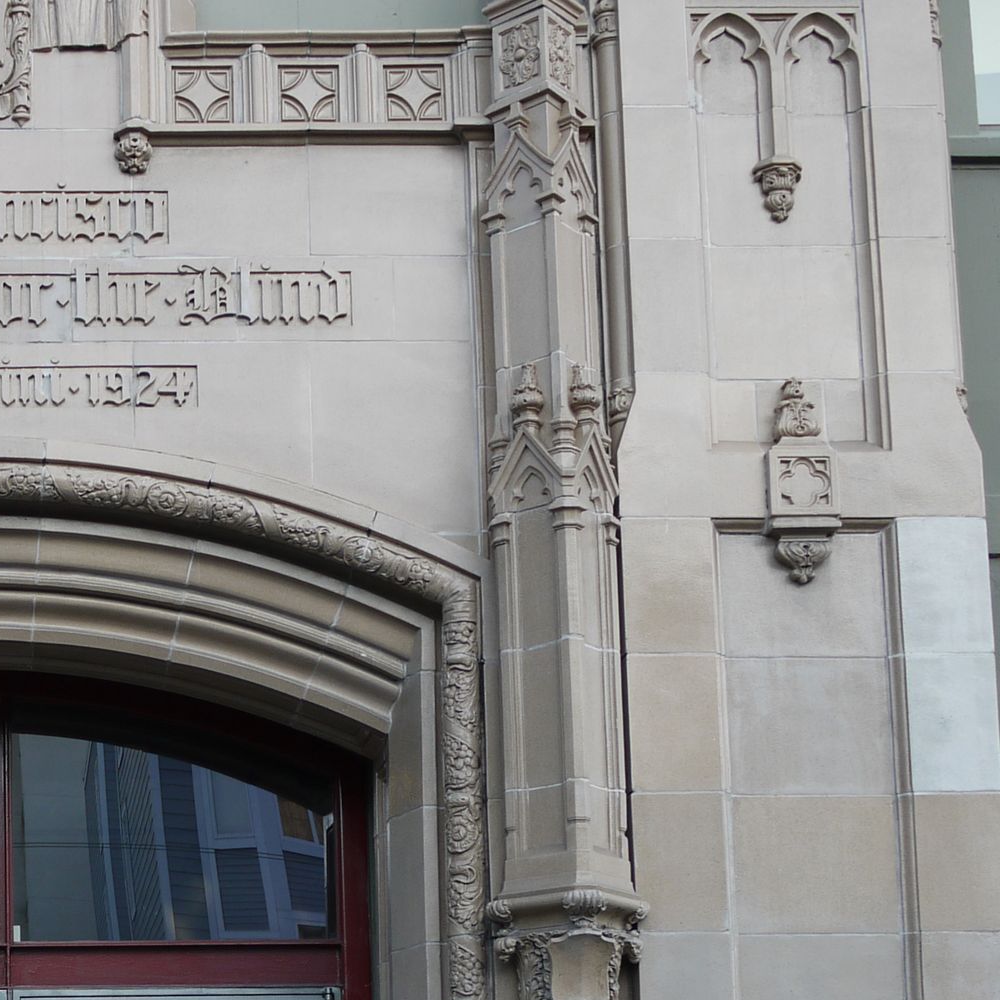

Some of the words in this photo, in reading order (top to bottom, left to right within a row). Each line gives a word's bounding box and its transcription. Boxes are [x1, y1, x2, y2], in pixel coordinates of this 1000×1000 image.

[71, 264, 160, 326] the
[178, 262, 348, 326] Blind
[85, 371, 195, 408] 1924
